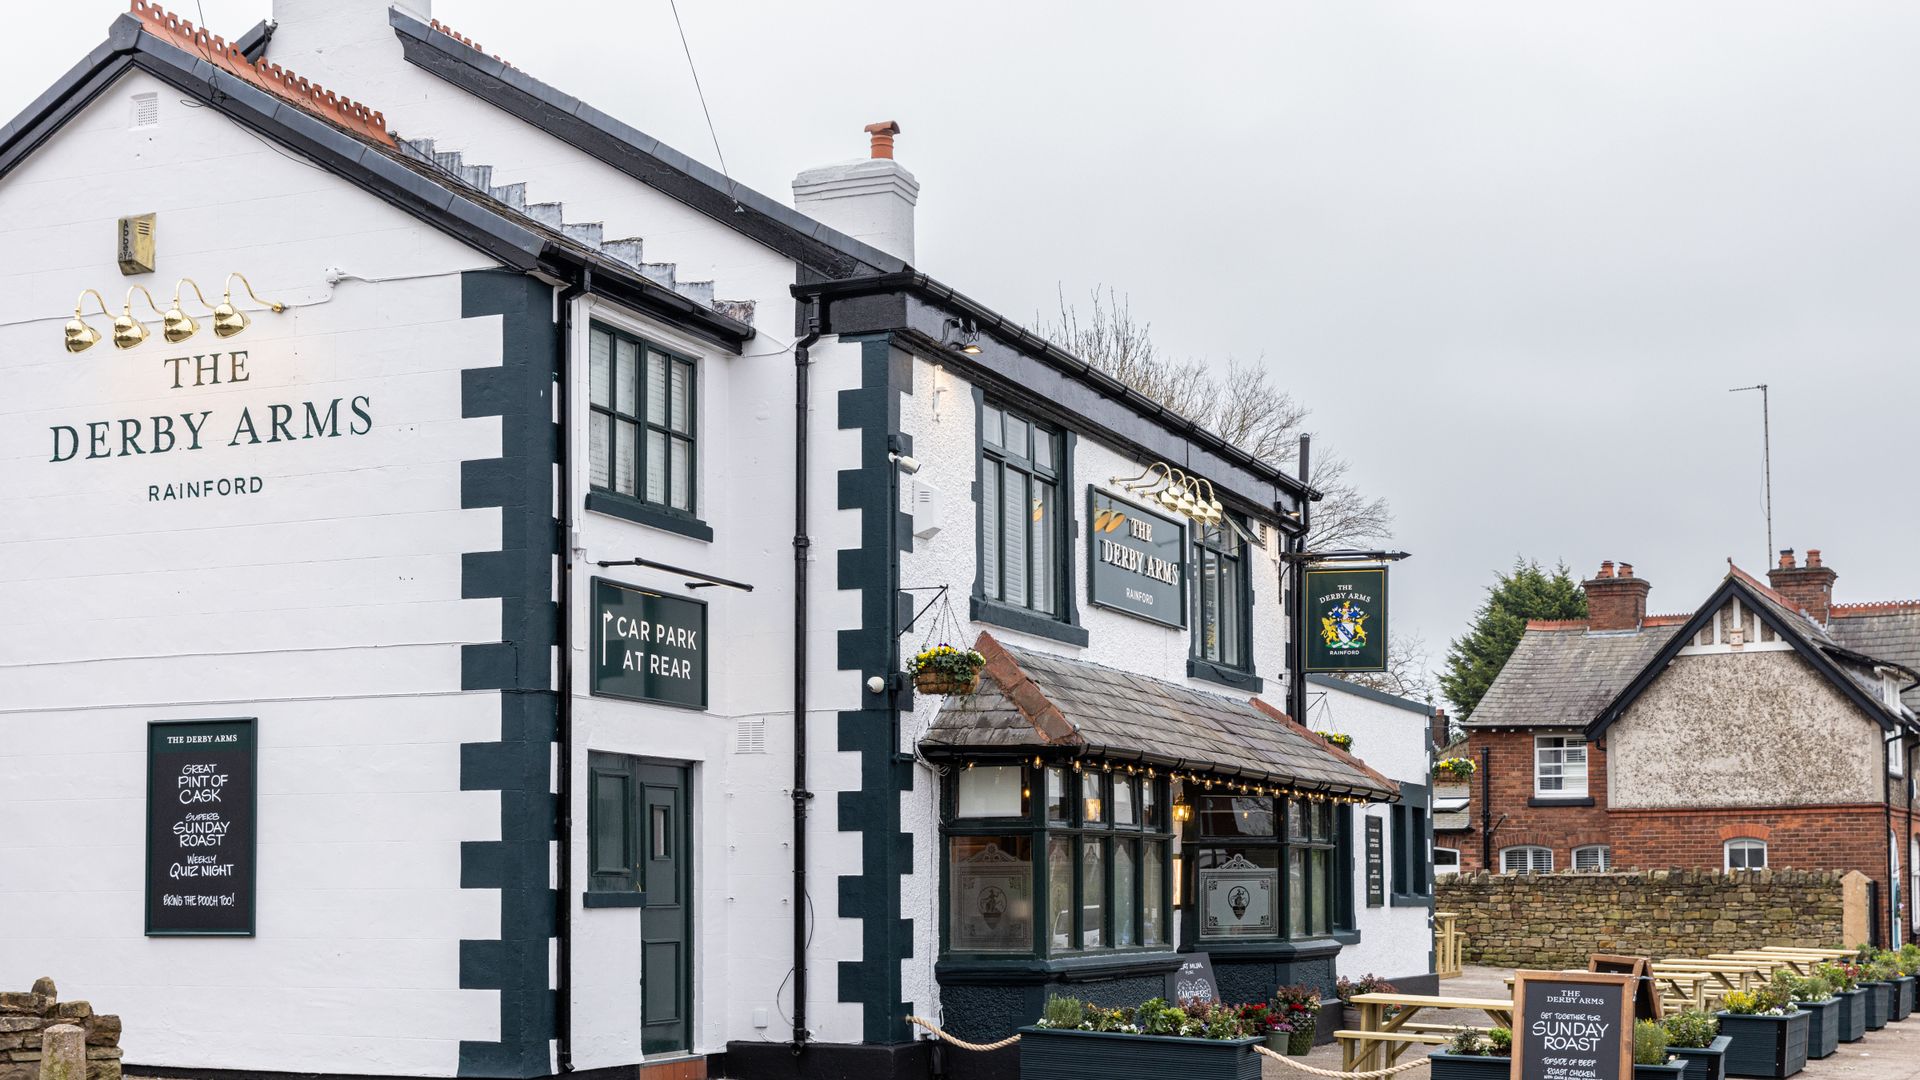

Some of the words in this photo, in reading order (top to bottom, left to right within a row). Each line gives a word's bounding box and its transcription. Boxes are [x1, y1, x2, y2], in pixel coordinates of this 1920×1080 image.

[164, 351, 250, 389] THE
[49, 410, 213, 463] DERBY
[227, 395, 373, 447] ARMS
[149, 476, 263, 502] RAINFORD
[1131, 517, 1152, 542] THE
[1104, 539, 1144, 574] DERBY
[1147, 555, 1178, 585] ARMS
[1126, 587, 1154, 605] RAINFORD
[1319, 592, 1347, 604] DERBY
[1347, 592, 1371, 603] ARMS
[617, 616, 650, 641] CAR
[656, 624, 697, 650] PARK
[622, 650, 644, 671] AT
[650, 654, 691, 680] REAR
[167, 736, 184, 744] THE
[186, 735, 213, 743] DERBY
[214, 734, 238, 742] ARMS
[182, 764, 217, 774] GREAT
[178, 775, 210, 788] PINT
[211, 774, 229, 787] OF
[179, 788, 222, 805] CASK
[185, 812, 220, 821] SUPERB
[172, 821, 231, 835] SUNDAY
[179, 834, 226, 848] ROAST
[187, 854, 217, 864] WEEKLY
[169, 863, 199, 880] QUIZ
[201, 864, 234, 877] NIGHT
[163, 893, 183, 906] BRING
[183, 895, 197, 906] THE
[197, 894, 218, 907] POOCH
[219, 892, 235, 907] TOO!
[1546, 996, 1578, 1004] DERBY
[1540, 1011, 1553, 1020] GET
[1554, 1013, 1586, 1021] TOGETHER
[1532, 1021, 1610, 1038] SUNDAY
[1544, 1036, 1601, 1052] ROAST
[1542, 1056, 1568, 1066] TOPSIDE
[1578, 1059, 1597, 1067] BEEF
[1547, 1067, 1568, 1076] ROAST
[1569, 1069, 1596, 1078] CHICKEN
